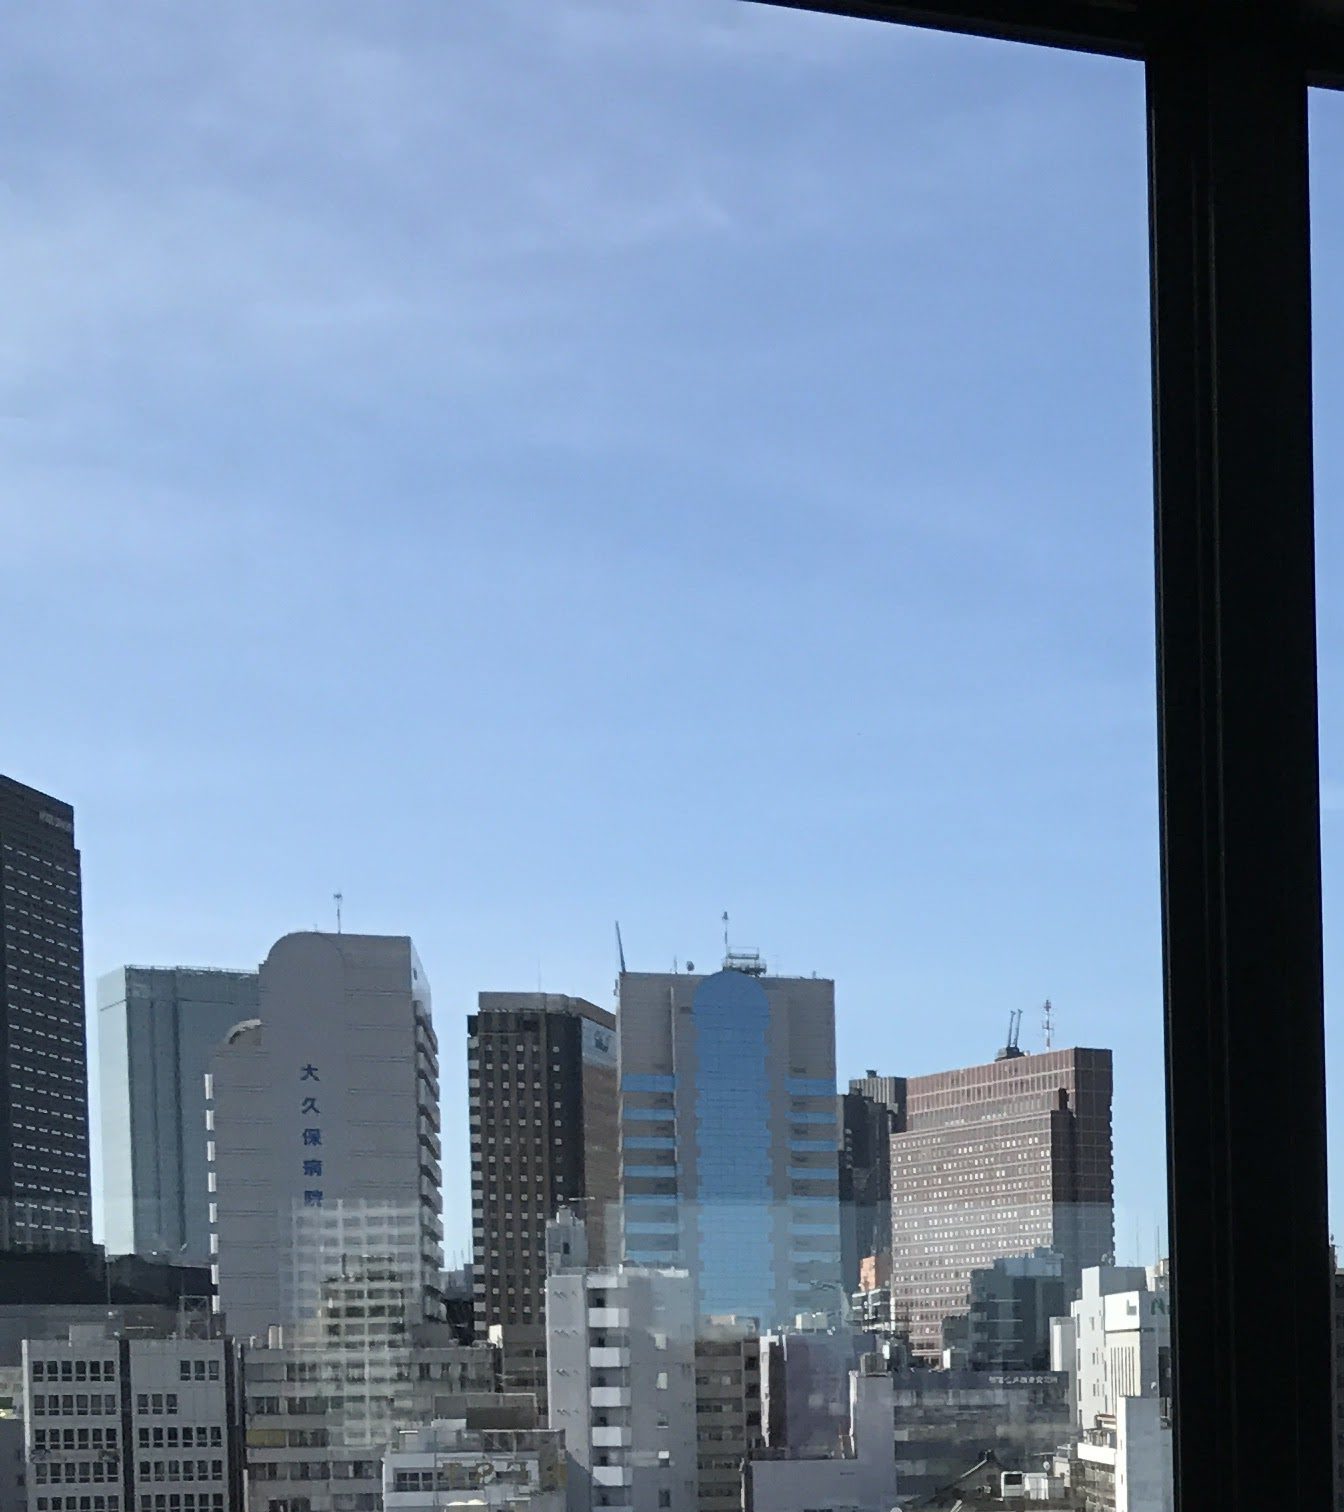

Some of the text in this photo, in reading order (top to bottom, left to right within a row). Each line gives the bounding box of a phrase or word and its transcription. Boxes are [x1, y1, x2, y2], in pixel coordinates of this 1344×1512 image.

[301, 1064, 323, 1207] 大久保病院
